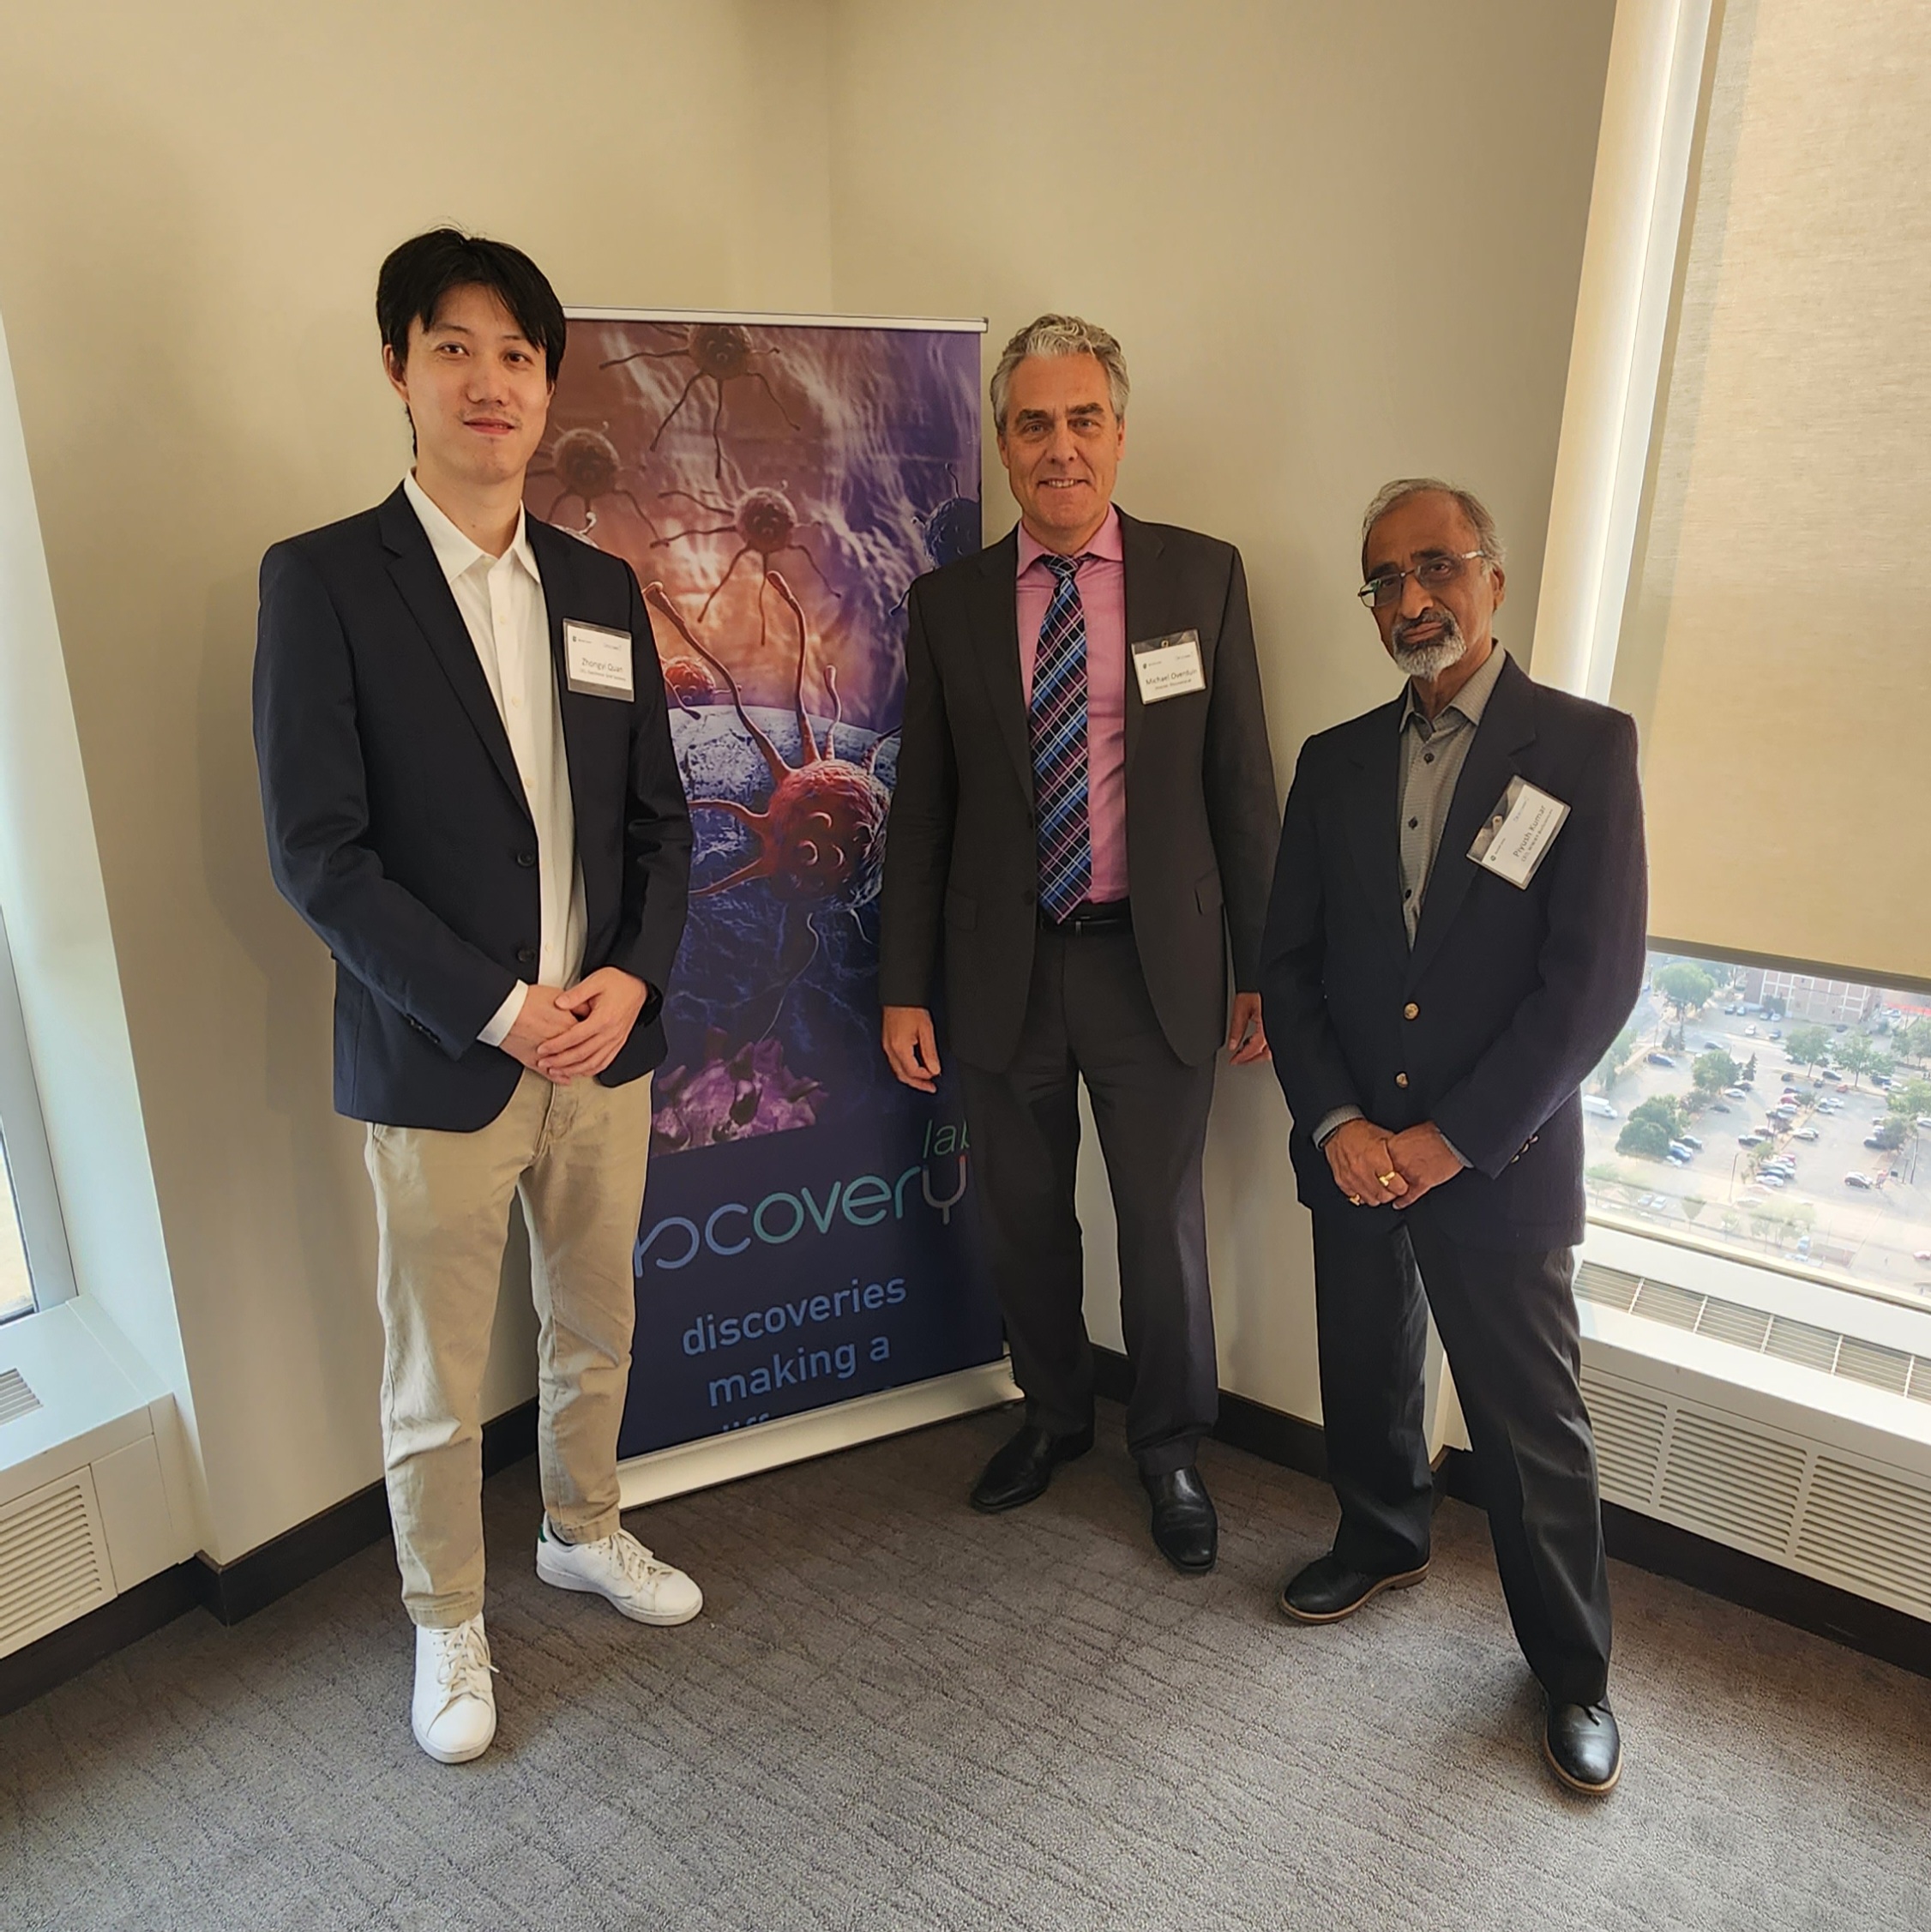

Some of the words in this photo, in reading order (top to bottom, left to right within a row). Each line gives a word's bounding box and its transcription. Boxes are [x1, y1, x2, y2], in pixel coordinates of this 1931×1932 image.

[1513, 832, 1532, 857] Piyush
[1529, 804, 1547, 832] Kumar
[682, 1277, 908, 1357] discoveries
[709, 1345, 857, 1407] making
[869, 1335, 891, 1362] a
